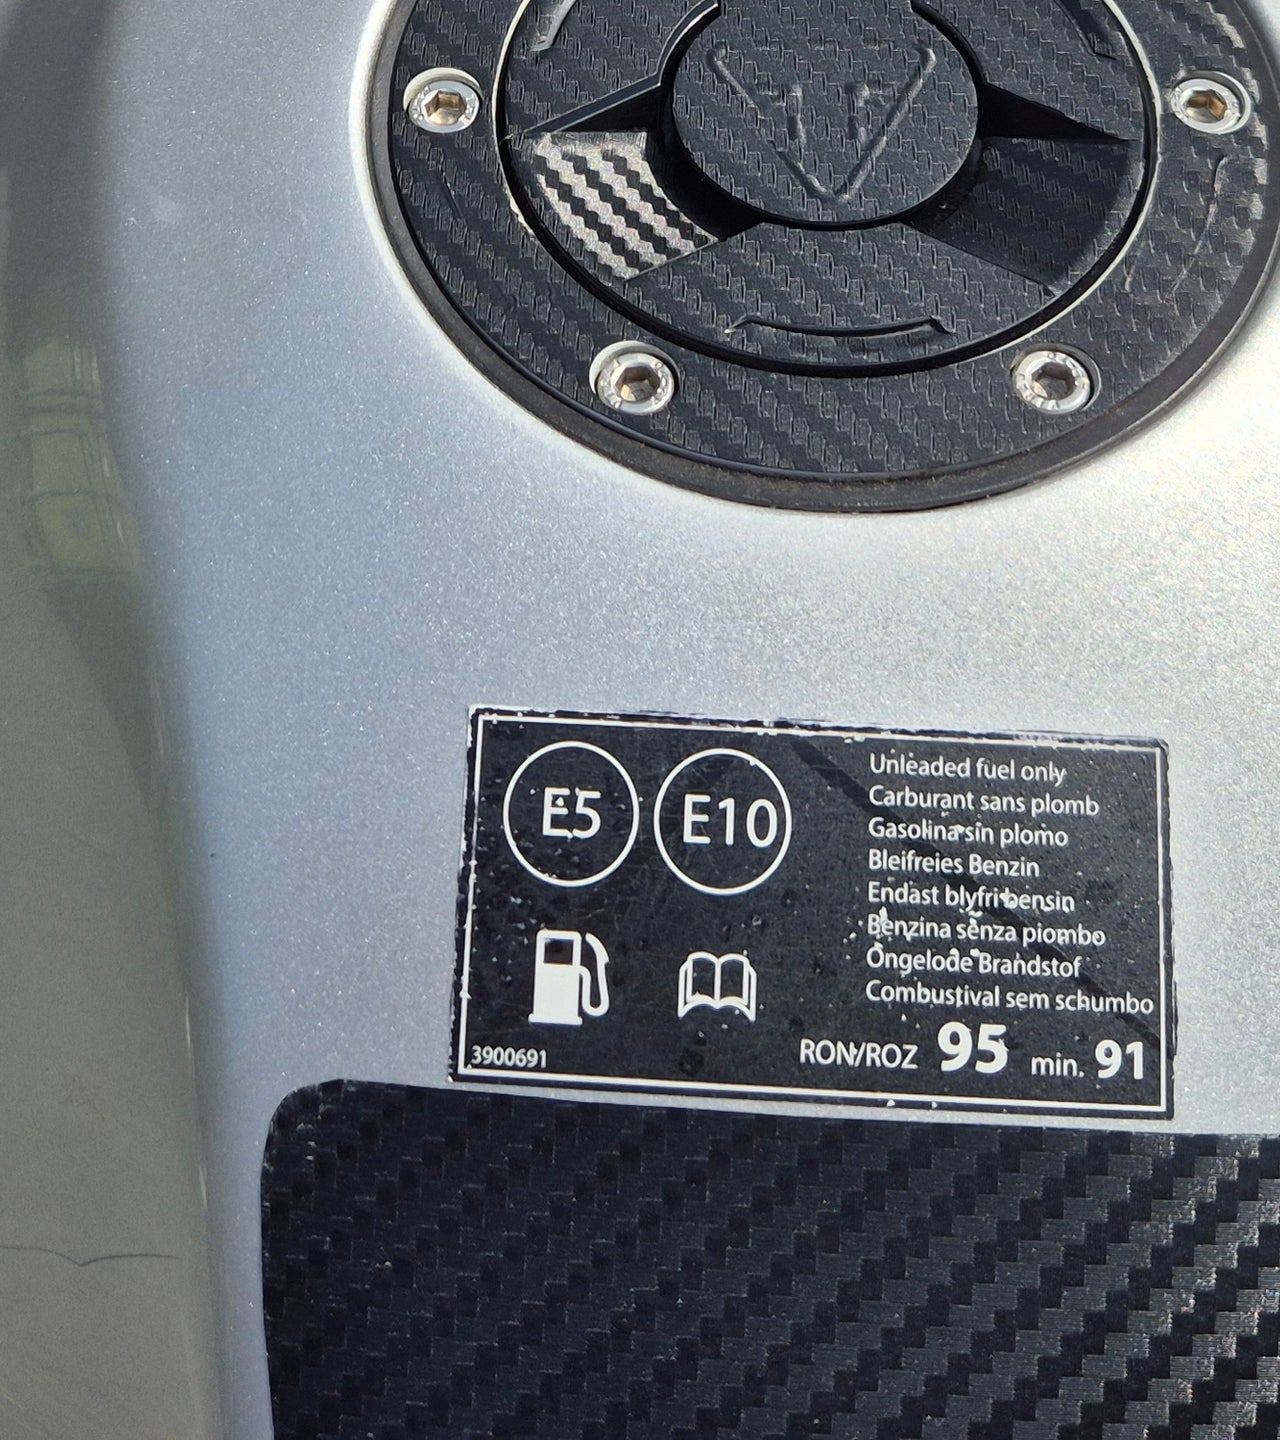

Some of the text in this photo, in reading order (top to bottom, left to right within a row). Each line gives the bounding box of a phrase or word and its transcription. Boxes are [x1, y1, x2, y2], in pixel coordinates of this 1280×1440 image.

[869, 752, 1068, 787] Unleaded fuel only
[542, 787, 602, 839] E5
[869, 785, 1100, 817] Carburant sans plomb
[683, 793, 779, 848] E10
[868, 816, 1069, 848] Gasolina sin plomo
[868, 848, 1040, 878] Bleifreies Benzin
[868, 881, 1075, 912] Endast blyfri bensin
[867, 913, 1107, 946] Benzina senza piombo
[978, 951, 1084, 978] Brandstof
[865, 979, 1155, 1015] Combustival sem schumbo
[471, 1044, 547, 1069] 3900691
[799, 1021, 1145, 1080] RON/ROZ 95 min. 91
